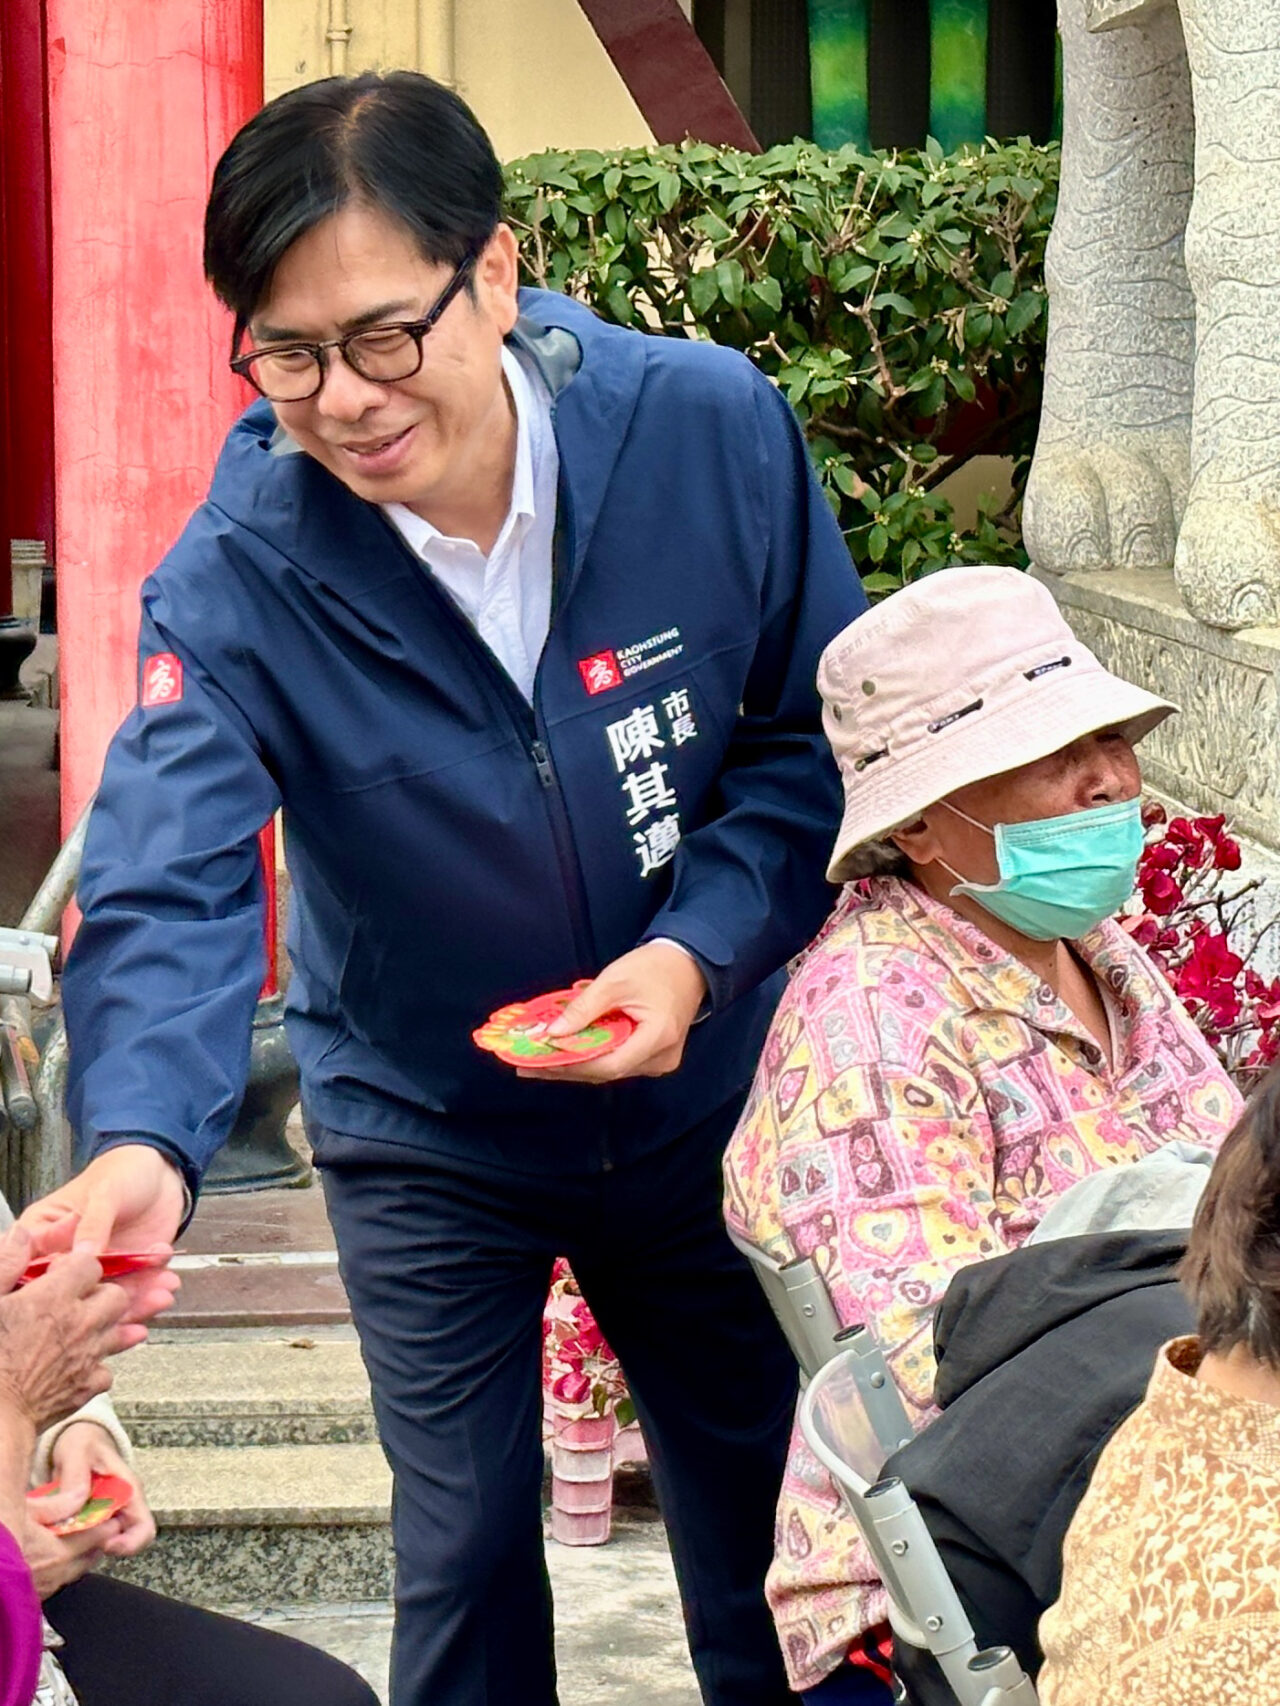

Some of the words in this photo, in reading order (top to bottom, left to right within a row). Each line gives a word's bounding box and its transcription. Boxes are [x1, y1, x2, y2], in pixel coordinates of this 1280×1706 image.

[617, 627, 680, 661] KAOHSIUNG
[623, 644, 684, 678] GOVERNMENT
[620, 654, 643, 669] CITY
[662, 688, 697, 747] 市長
[605, 703, 683, 878] 陳其邁
